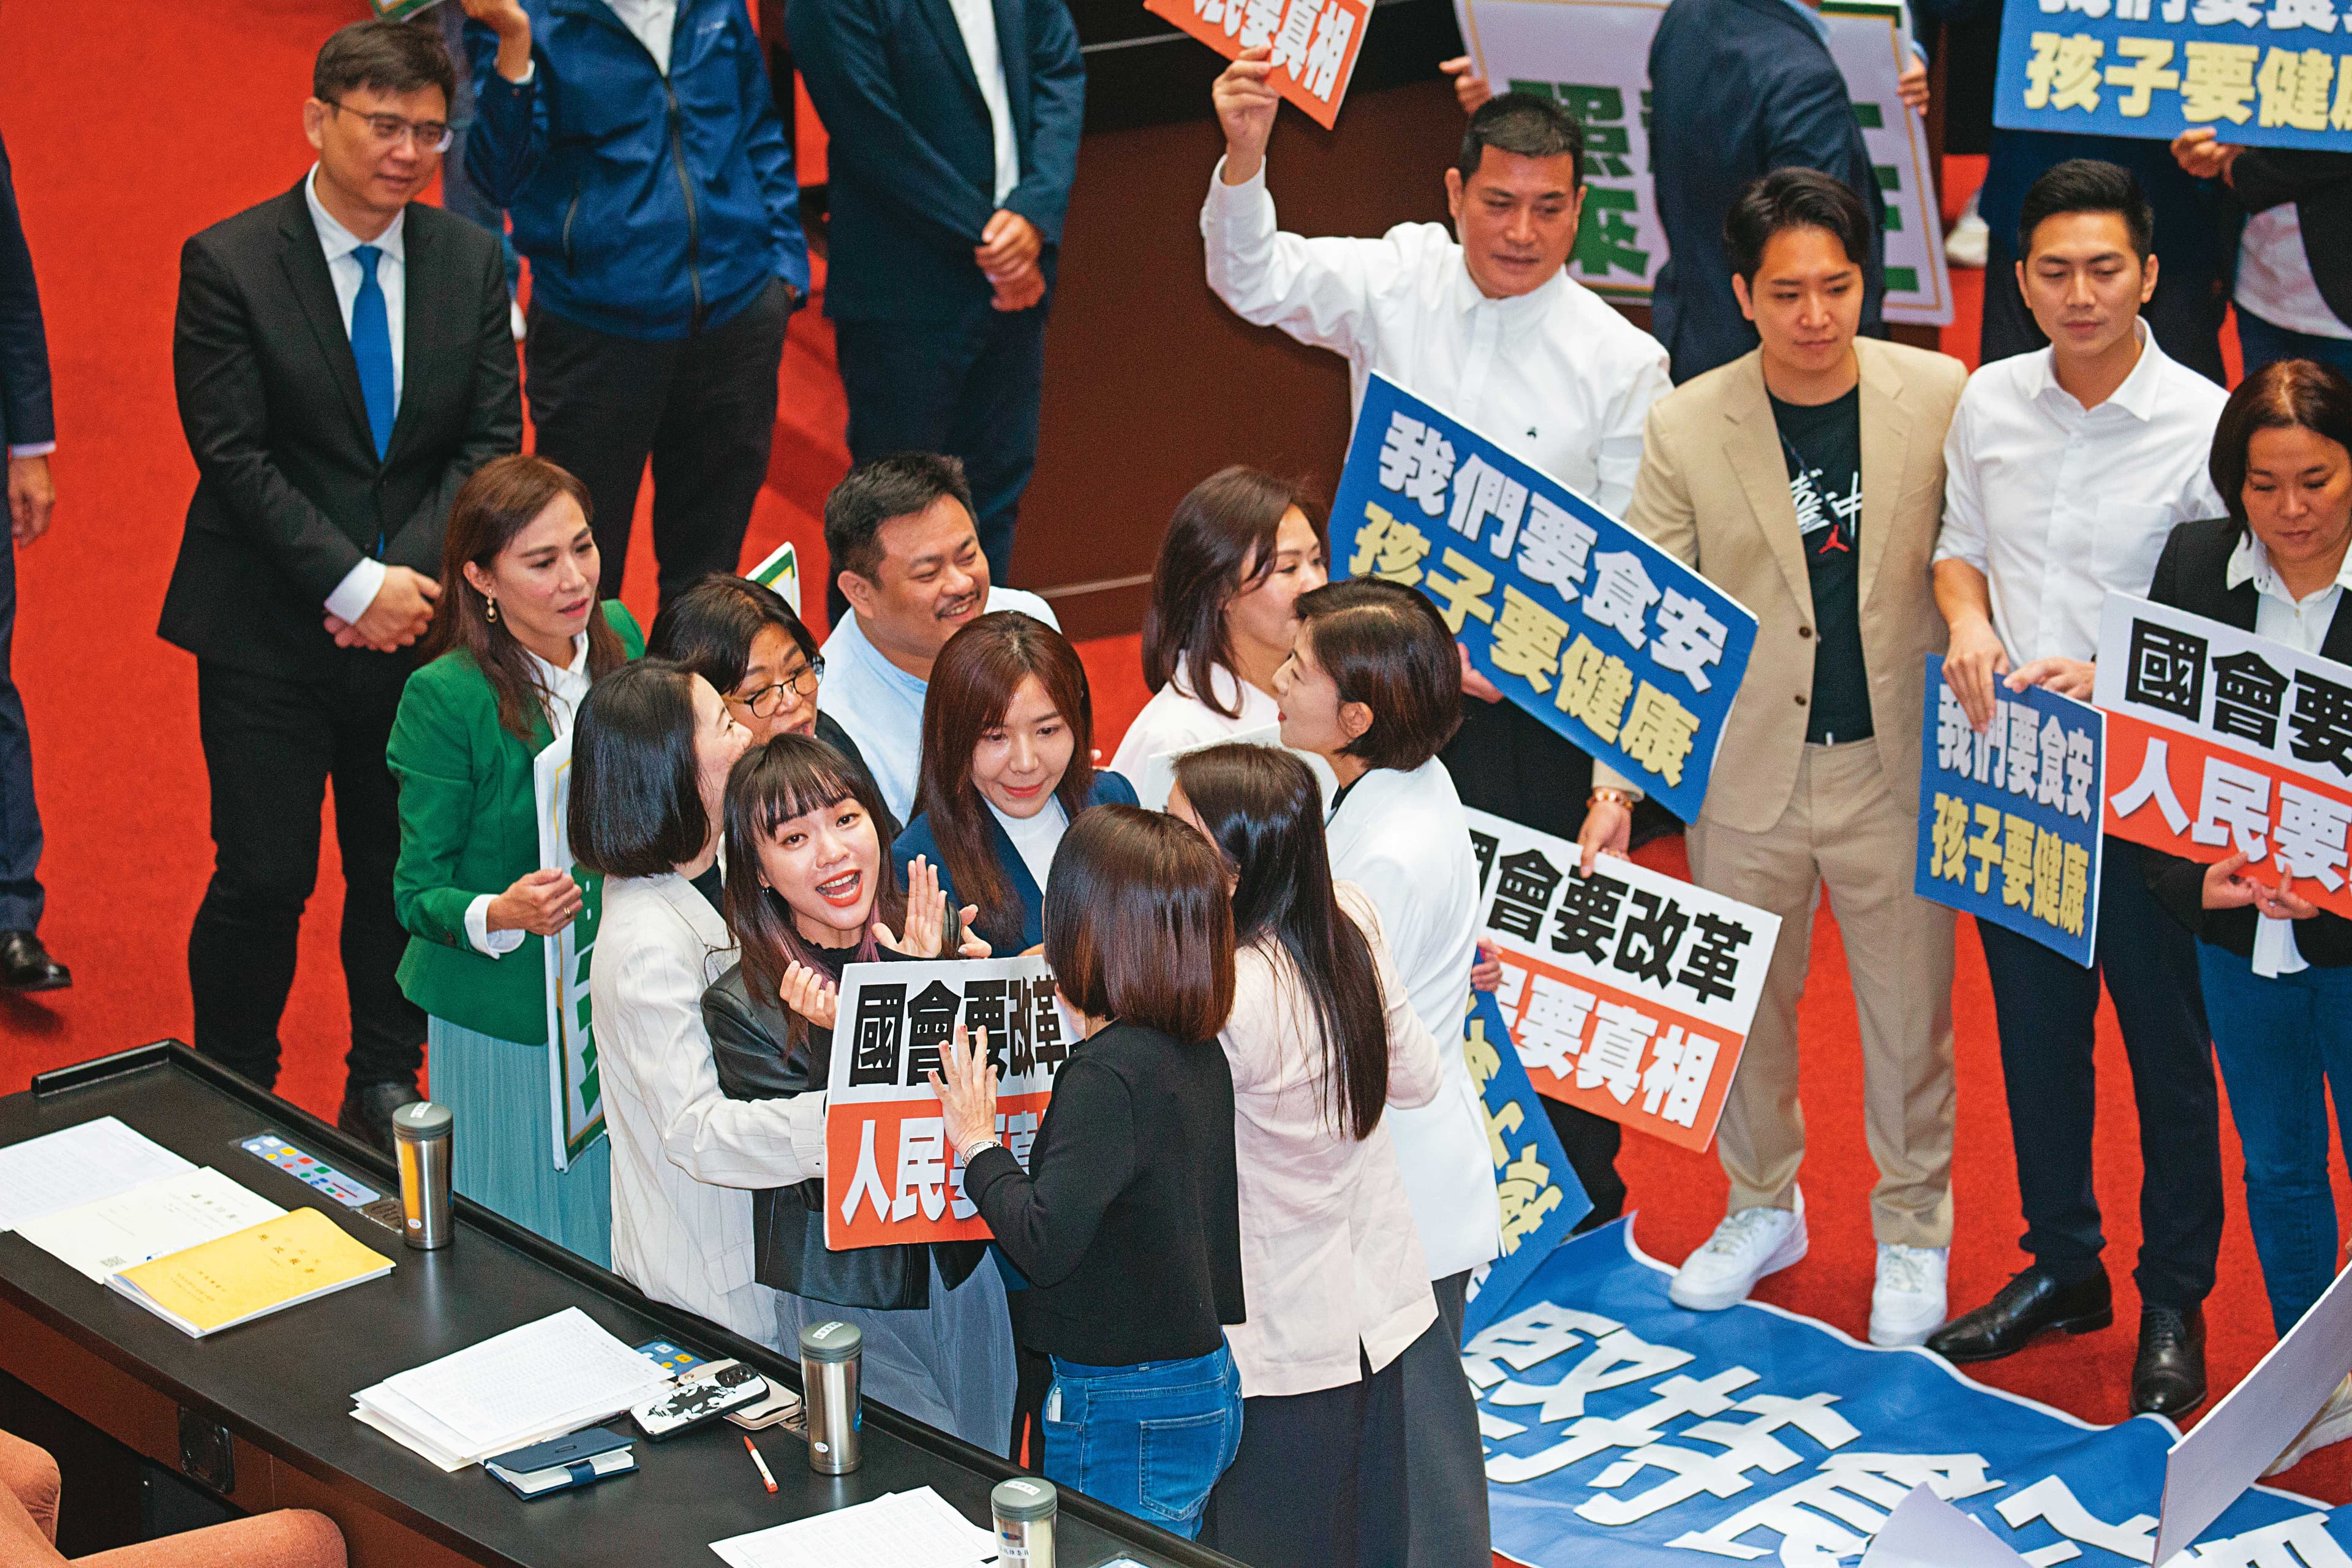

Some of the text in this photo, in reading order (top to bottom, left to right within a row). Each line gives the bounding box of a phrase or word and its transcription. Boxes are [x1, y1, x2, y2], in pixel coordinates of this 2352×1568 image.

[1379, 411, 1728, 693] 我們要食安
[1349, 501, 1700, 788] 孩子要健康
[2125, 617, 2352, 778] 國會要
[1937, 684, 2094, 823] 我們要食安
[2109, 737, 2352, 892] 人民要
[1469, 828, 1753, 1005] 會要改革
[1931, 793, 2089, 938] 孩子要健康
[848, 974, 1070, 1088] 國會要改革
